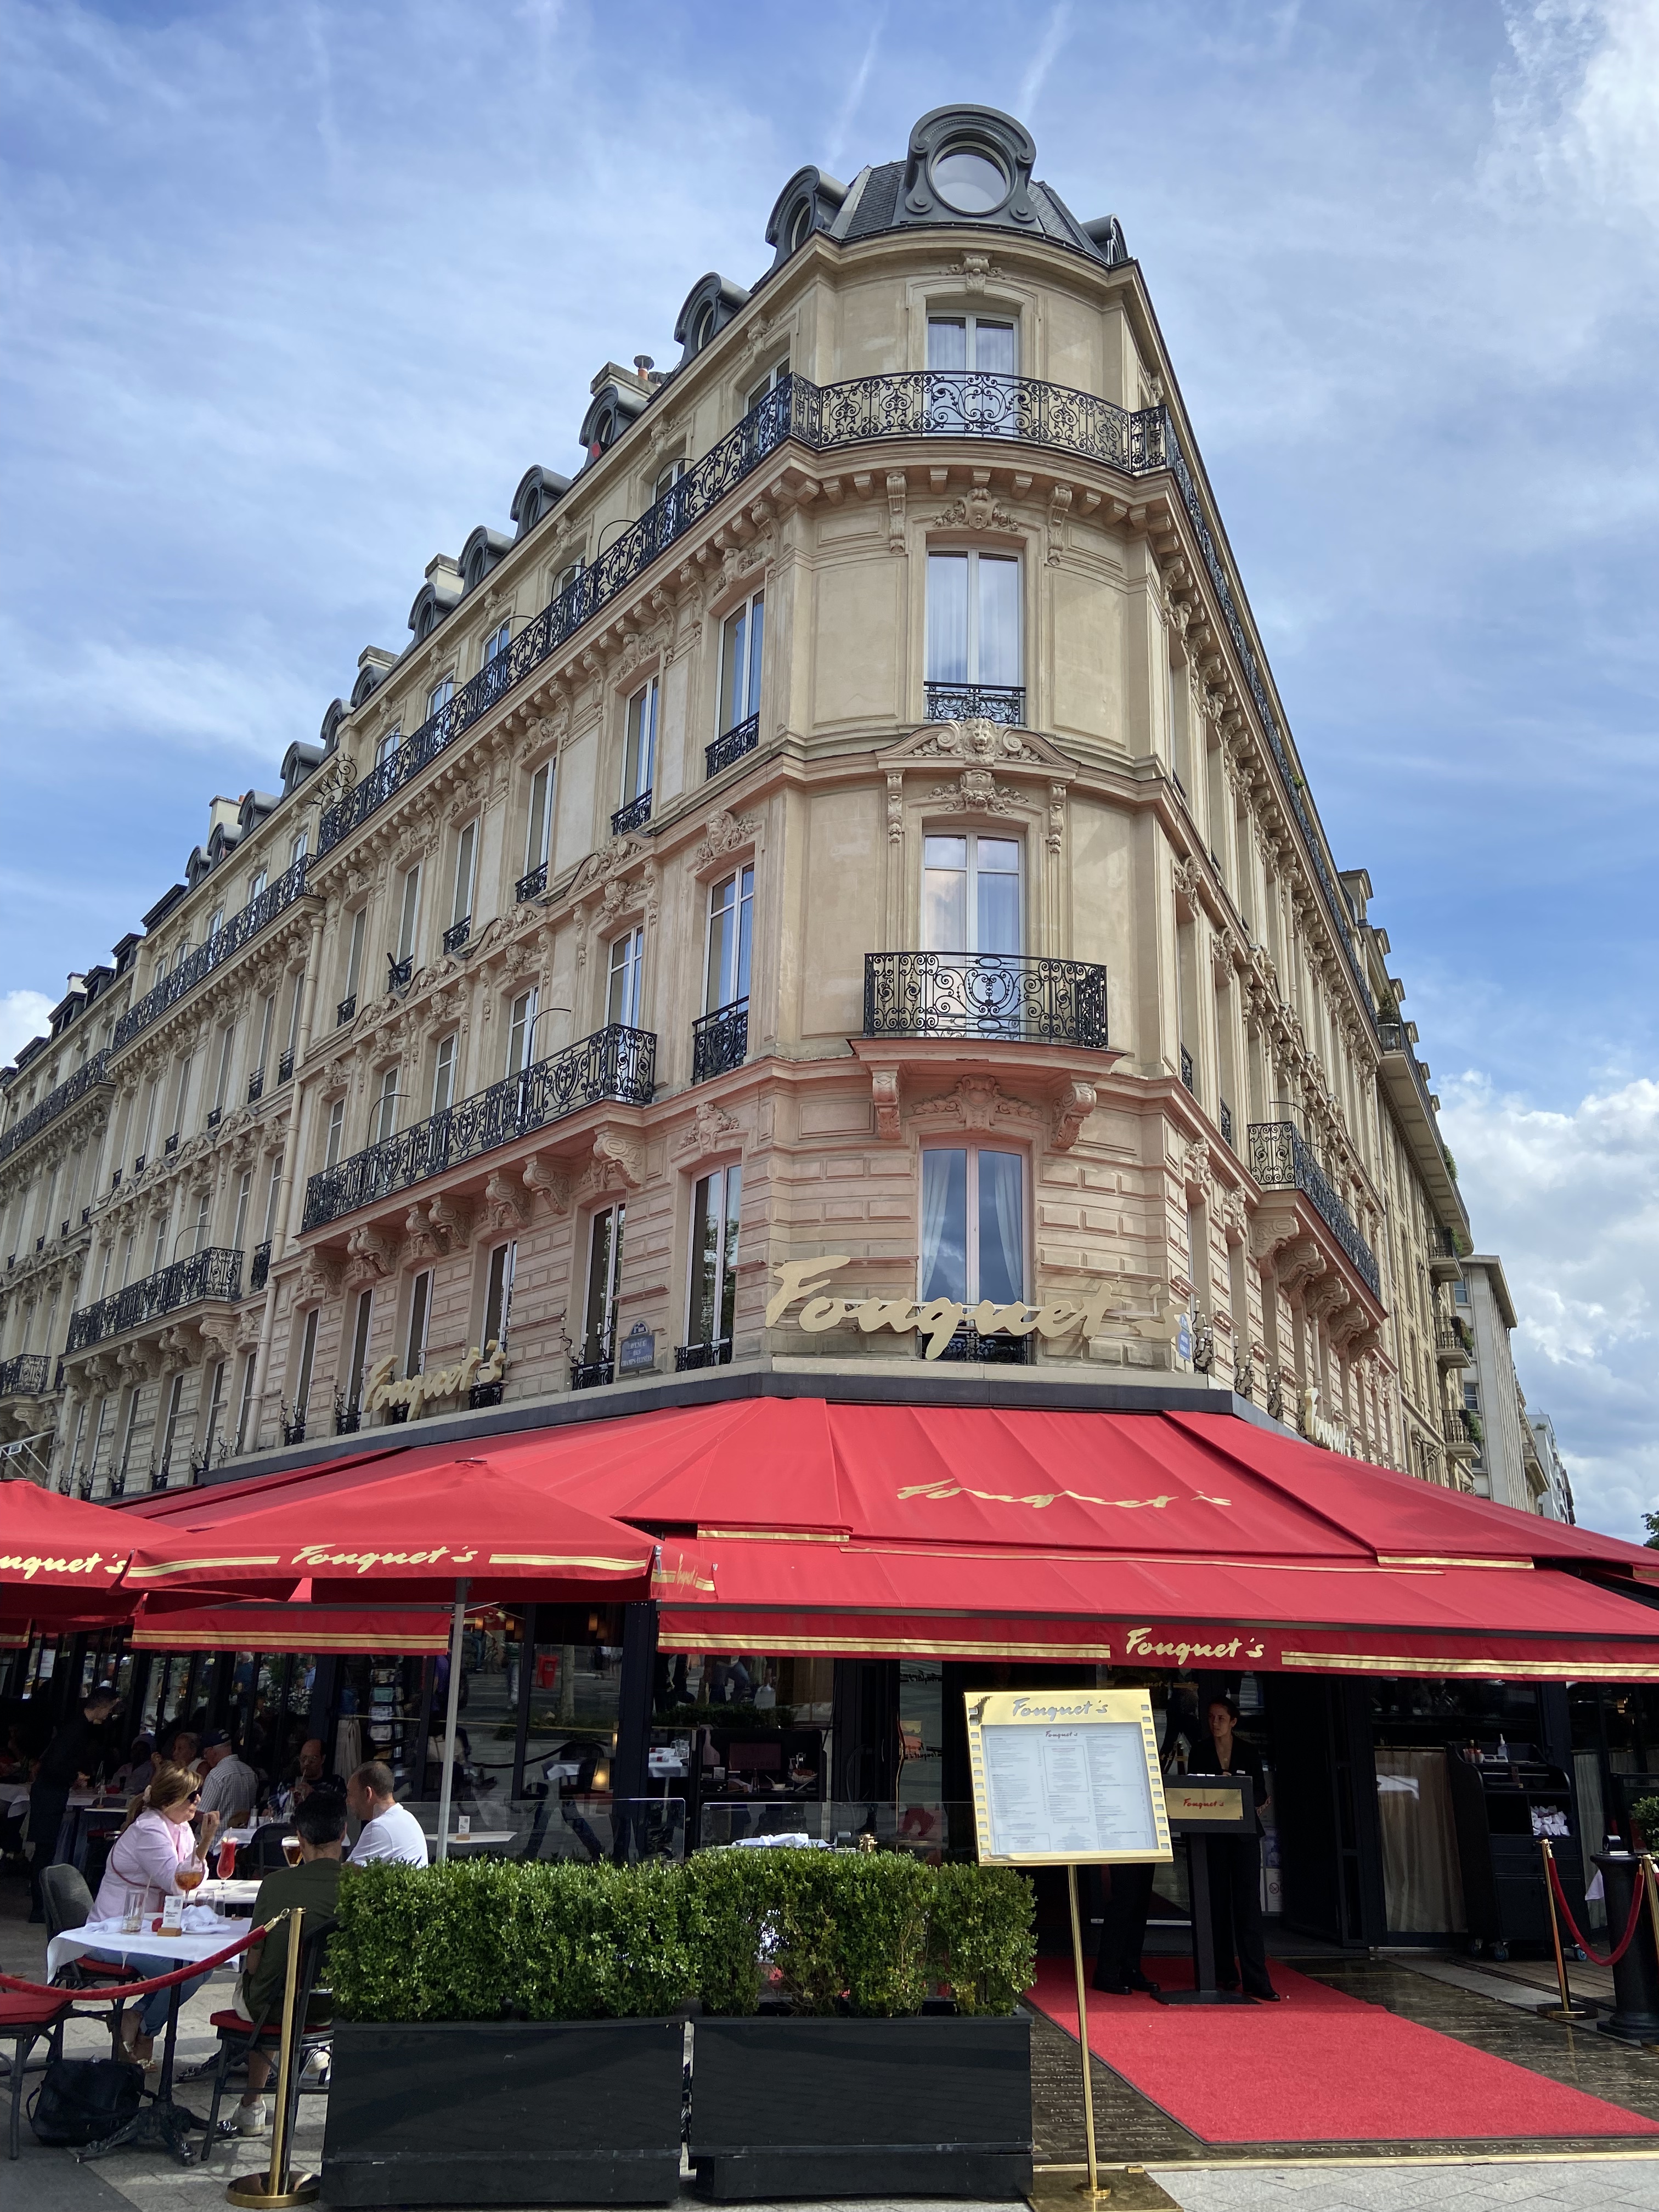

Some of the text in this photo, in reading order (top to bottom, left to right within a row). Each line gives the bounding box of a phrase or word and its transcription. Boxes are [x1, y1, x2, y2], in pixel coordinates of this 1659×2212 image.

[766, 1255, 1187, 1361] Fouquet's
[363, 1339, 506, 1422] Fouquet's
[0, 1553, 127, 1580] uquet's
[291, 1544, 478, 1574] Fouquet's
[1126, 1627, 1265, 1665] Fouquet's
[1013, 1697, 1108, 1722] Fouquet's
[1045, 1730, 1078, 1739] Fouquet's
[1183, 1798, 1224, 1810] Fouquet's
